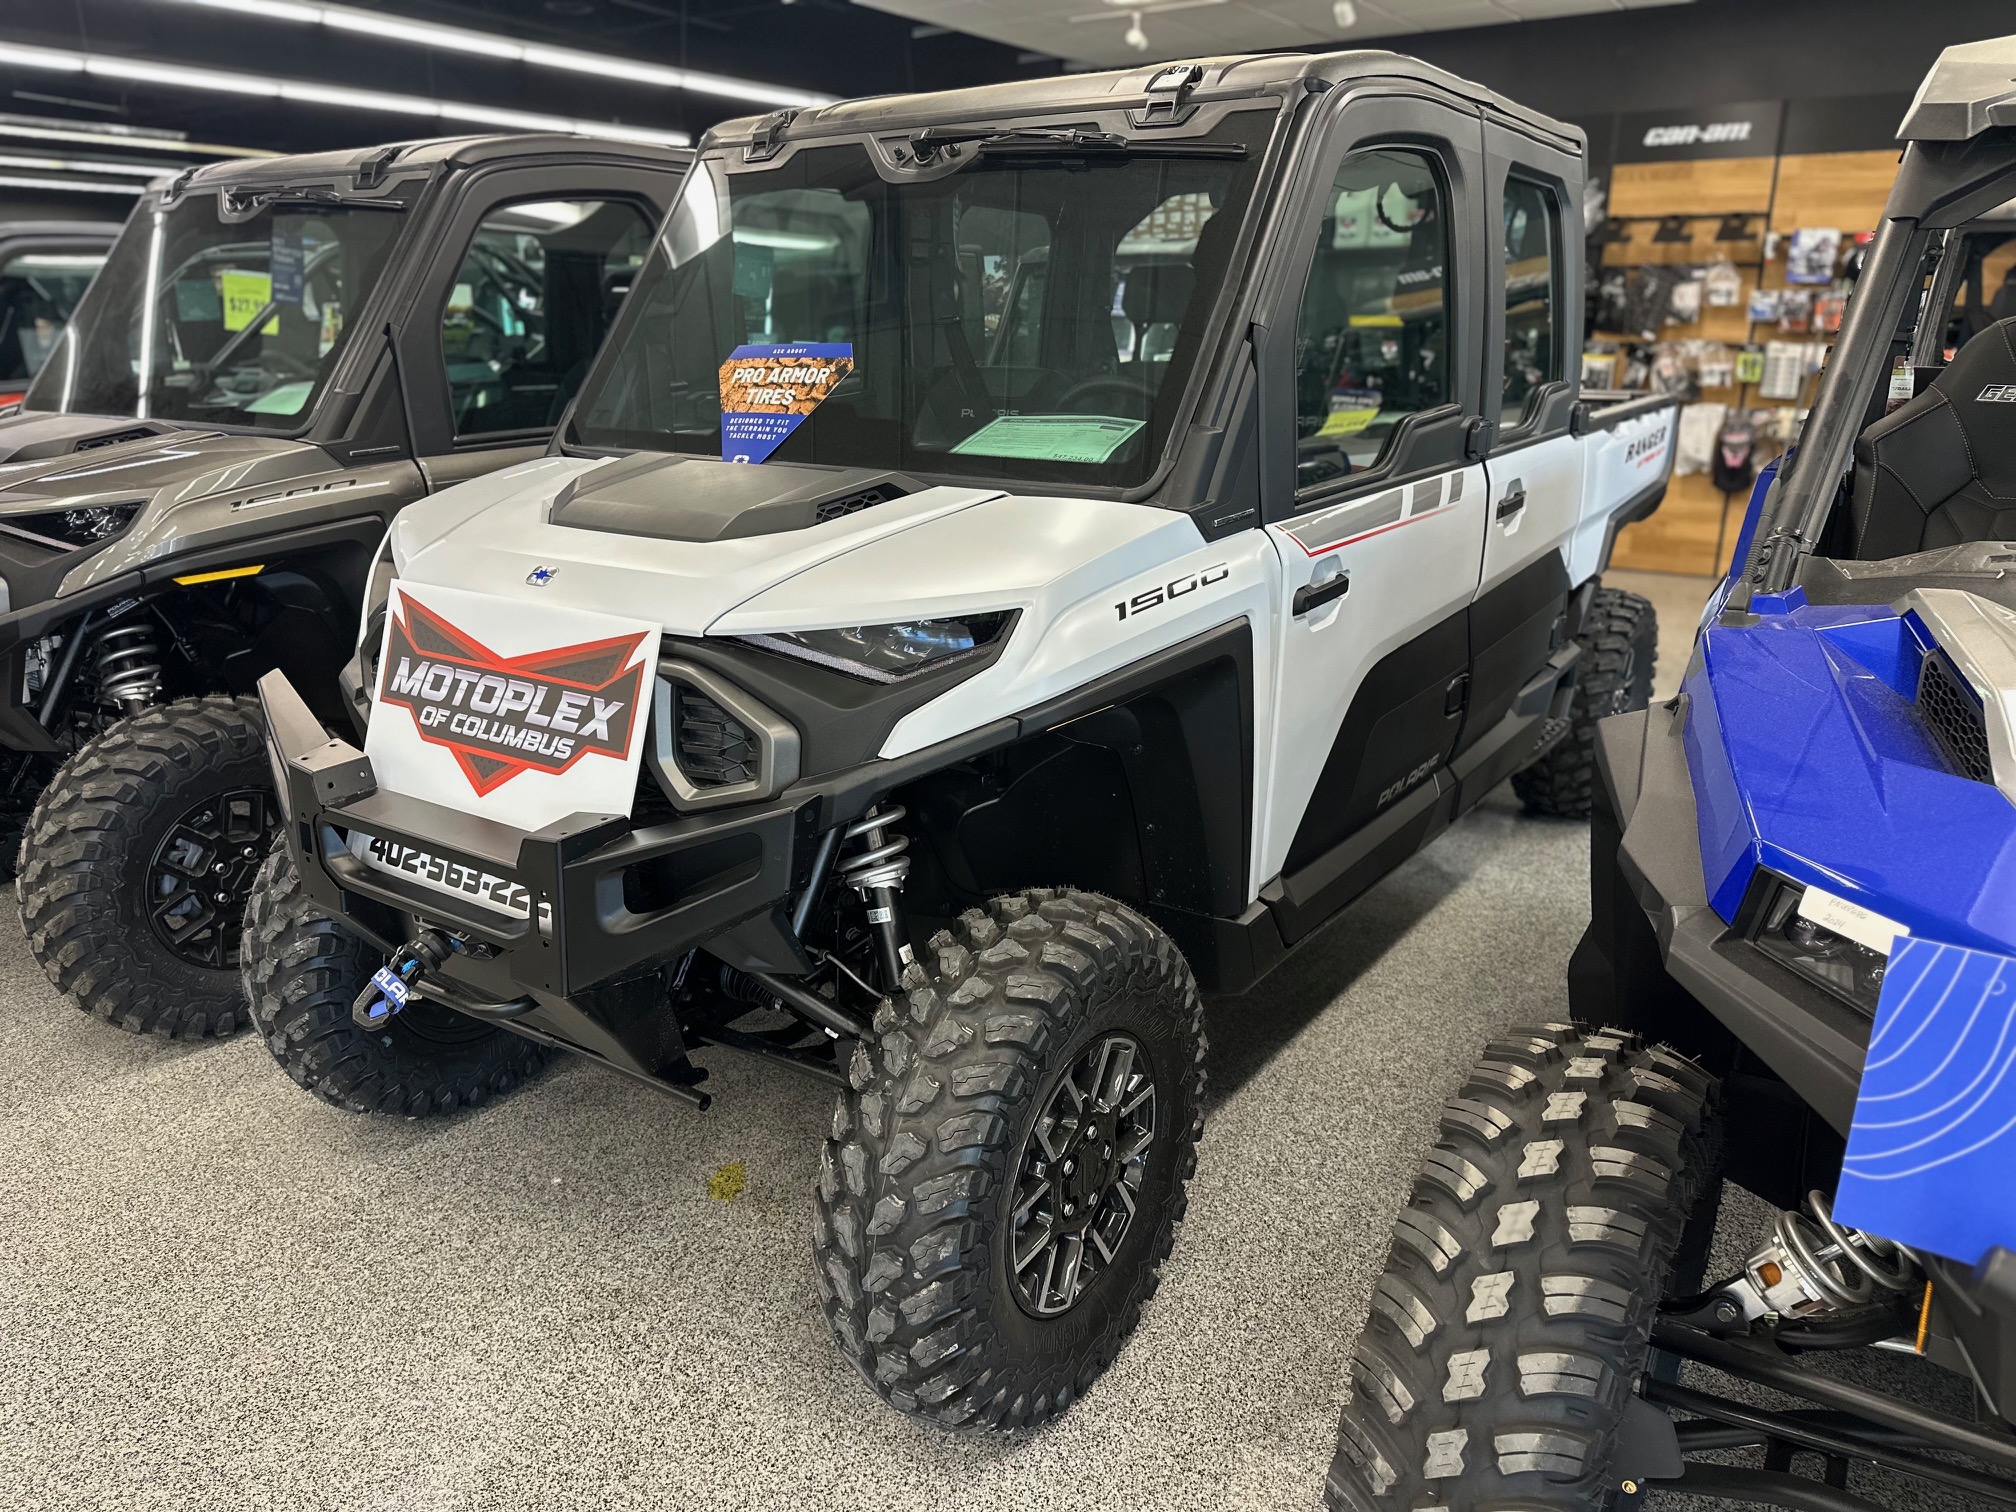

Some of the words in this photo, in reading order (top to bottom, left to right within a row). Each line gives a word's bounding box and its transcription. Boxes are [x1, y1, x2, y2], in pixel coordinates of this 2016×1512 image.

[1643, 121, 1752, 147] can-am
[731, 367, 766, 383] PRO
[766, 367, 831, 383] ARMOR
[745, 388, 796, 405] TIRES
[1625, 426, 1667, 464] RANGER
[1114, 562, 1229, 621] 1500
[390, 656, 625, 741] MOTOPLEX
[419, 706, 451, 728] OF
[450, 713, 576, 760] COLUMBUS
[1377, 753, 1440, 807] POLARIS
